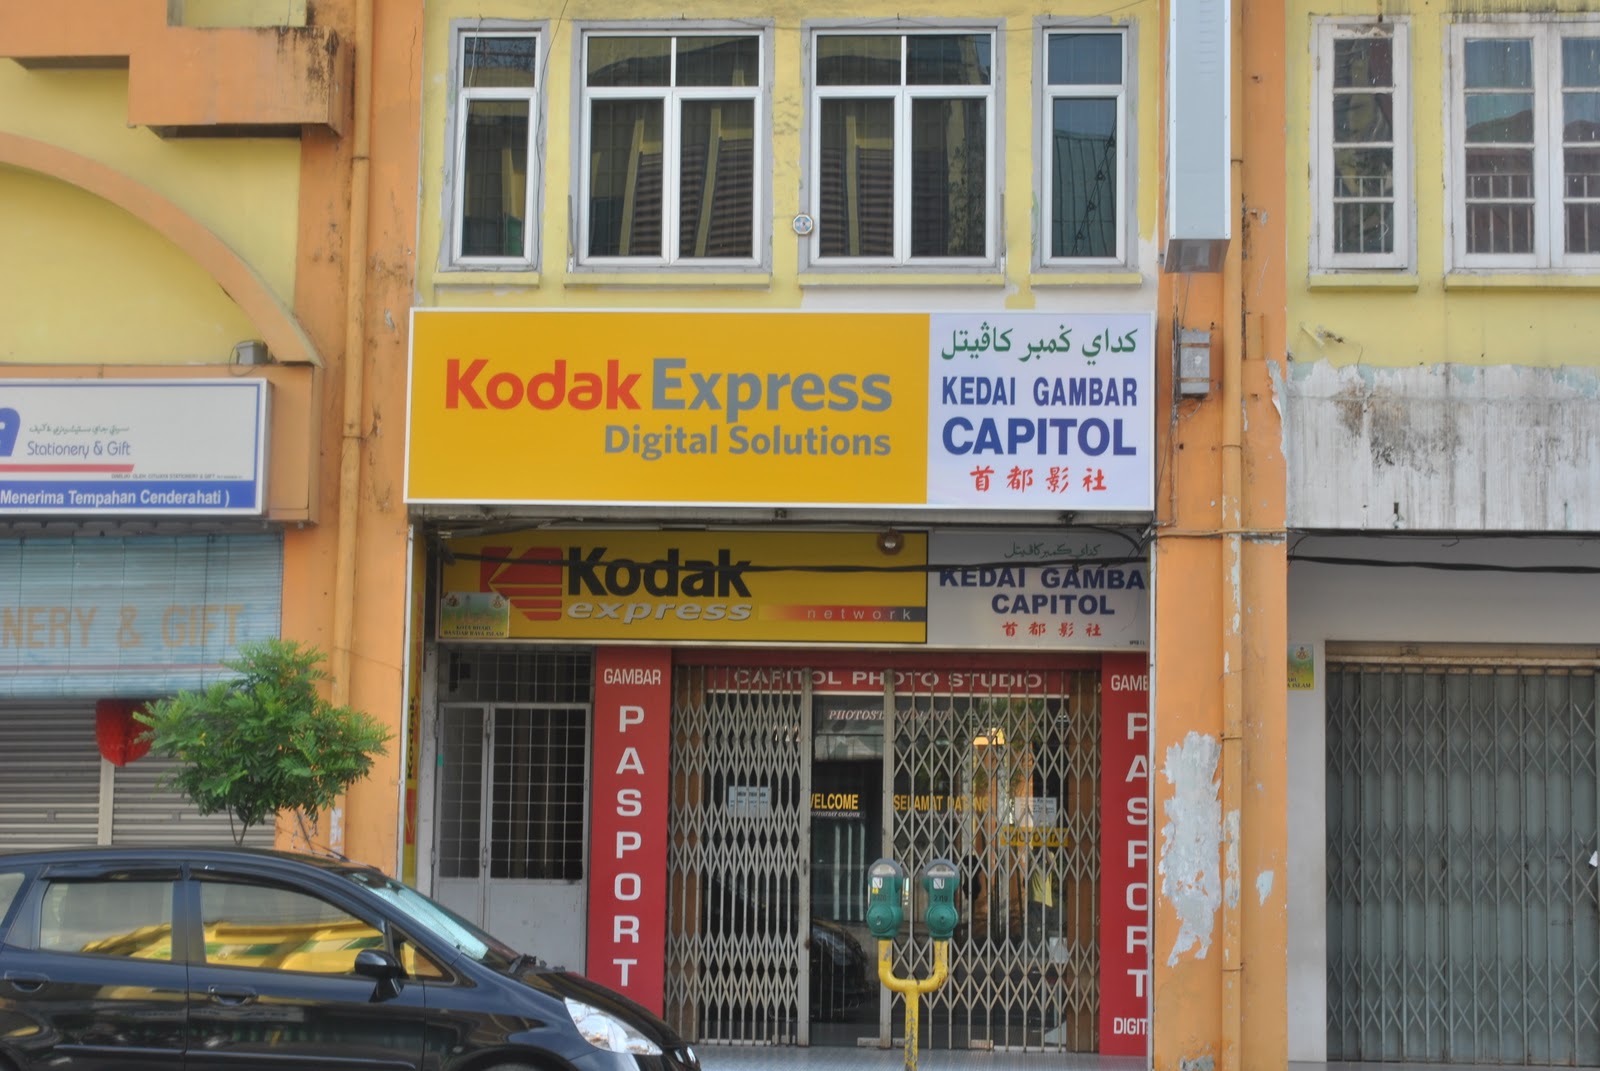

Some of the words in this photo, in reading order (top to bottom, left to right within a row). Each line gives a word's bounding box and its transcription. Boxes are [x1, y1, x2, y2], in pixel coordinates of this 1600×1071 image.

[445, 359, 642, 411] Kodak
[651, 358, 893, 424] Express
[942, 376, 1016, 405] KEDAI
[1033, 377, 1138, 407] GAMBAR
[27, 440, 90, 459] Stationery
[93, 440, 104, 456] &
[106, 440, 131, 457] Gift
[604, 424, 717, 461] Digital
[728, 425, 892, 456] Solutions
[942, 416, 1137, 457] CAPITOL
[970, 465, 1107, 494] 首都影社
[0, 489, 64, 505] Menerima
[68, 490, 136, 508] Tempahan
[140, 489, 222, 505] Cenderahati
[567, 547, 752, 598] Kodak
[939, 567, 1026, 588] KEDAI
[567, 602, 753, 625] express
[806, 608, 913, 622] network
[991, 594, 1115, 616] CAPITOL
[161, 604, 245, 647] GIFT
[1002, 621, 1103, 638] 首都影社
[603, 669, 662, 685] GAMBAR
[949, 672, 1042, 688] STUDIO
[613, 705, 645, 987] PASPORT
